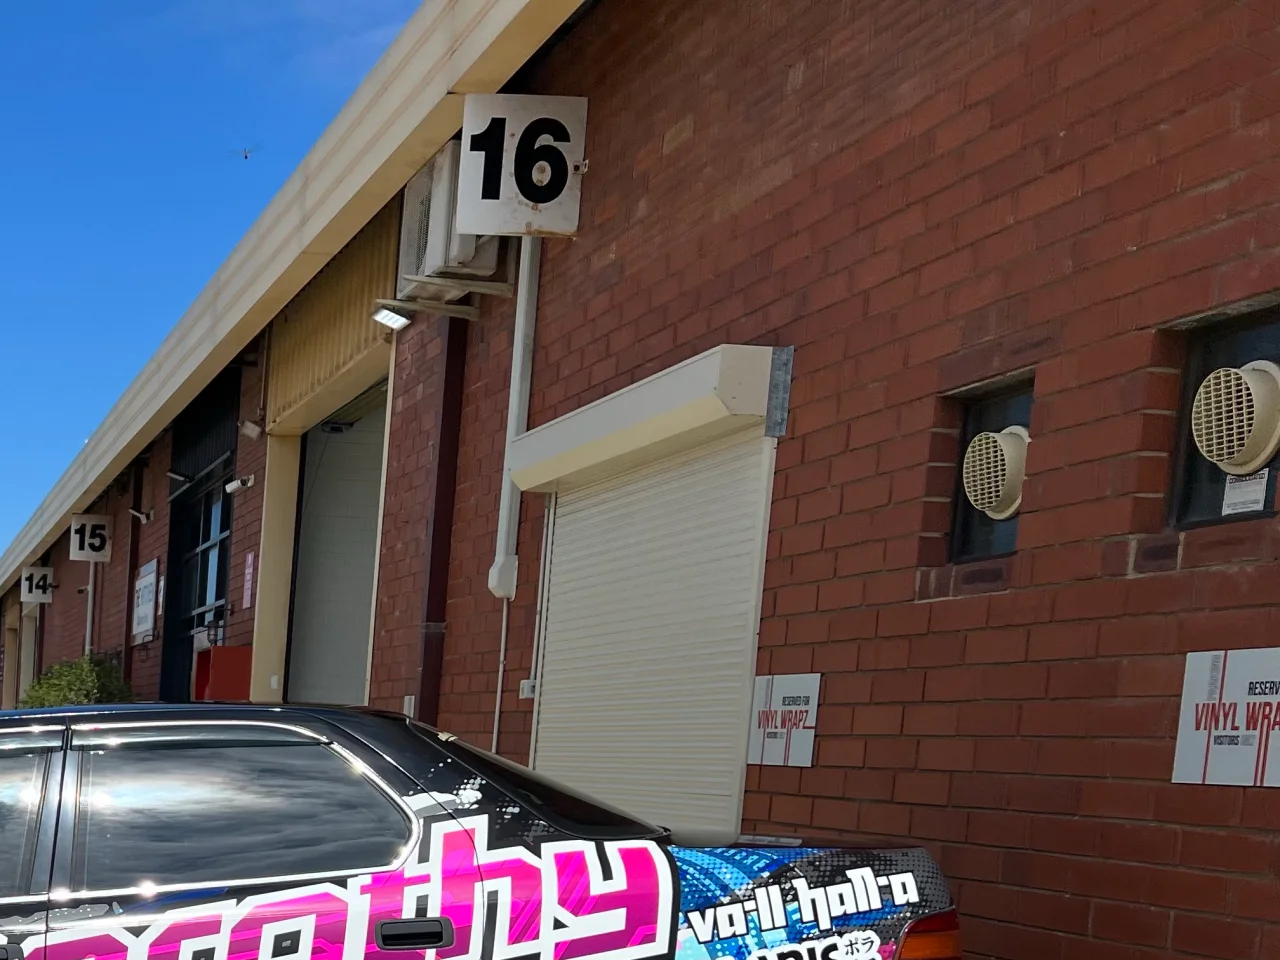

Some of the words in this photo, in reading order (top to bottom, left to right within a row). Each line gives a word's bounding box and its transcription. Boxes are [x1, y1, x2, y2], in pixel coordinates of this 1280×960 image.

[469, 117, 571, 204] 16
[74, 523, 107, 552] 15
[24, 573, 50, 594] 14
[758, 710, 778, 729] VINYL
[781, 710, 813, 729] WRAPZ
[1195, 702, 1240, 731] VINYL
